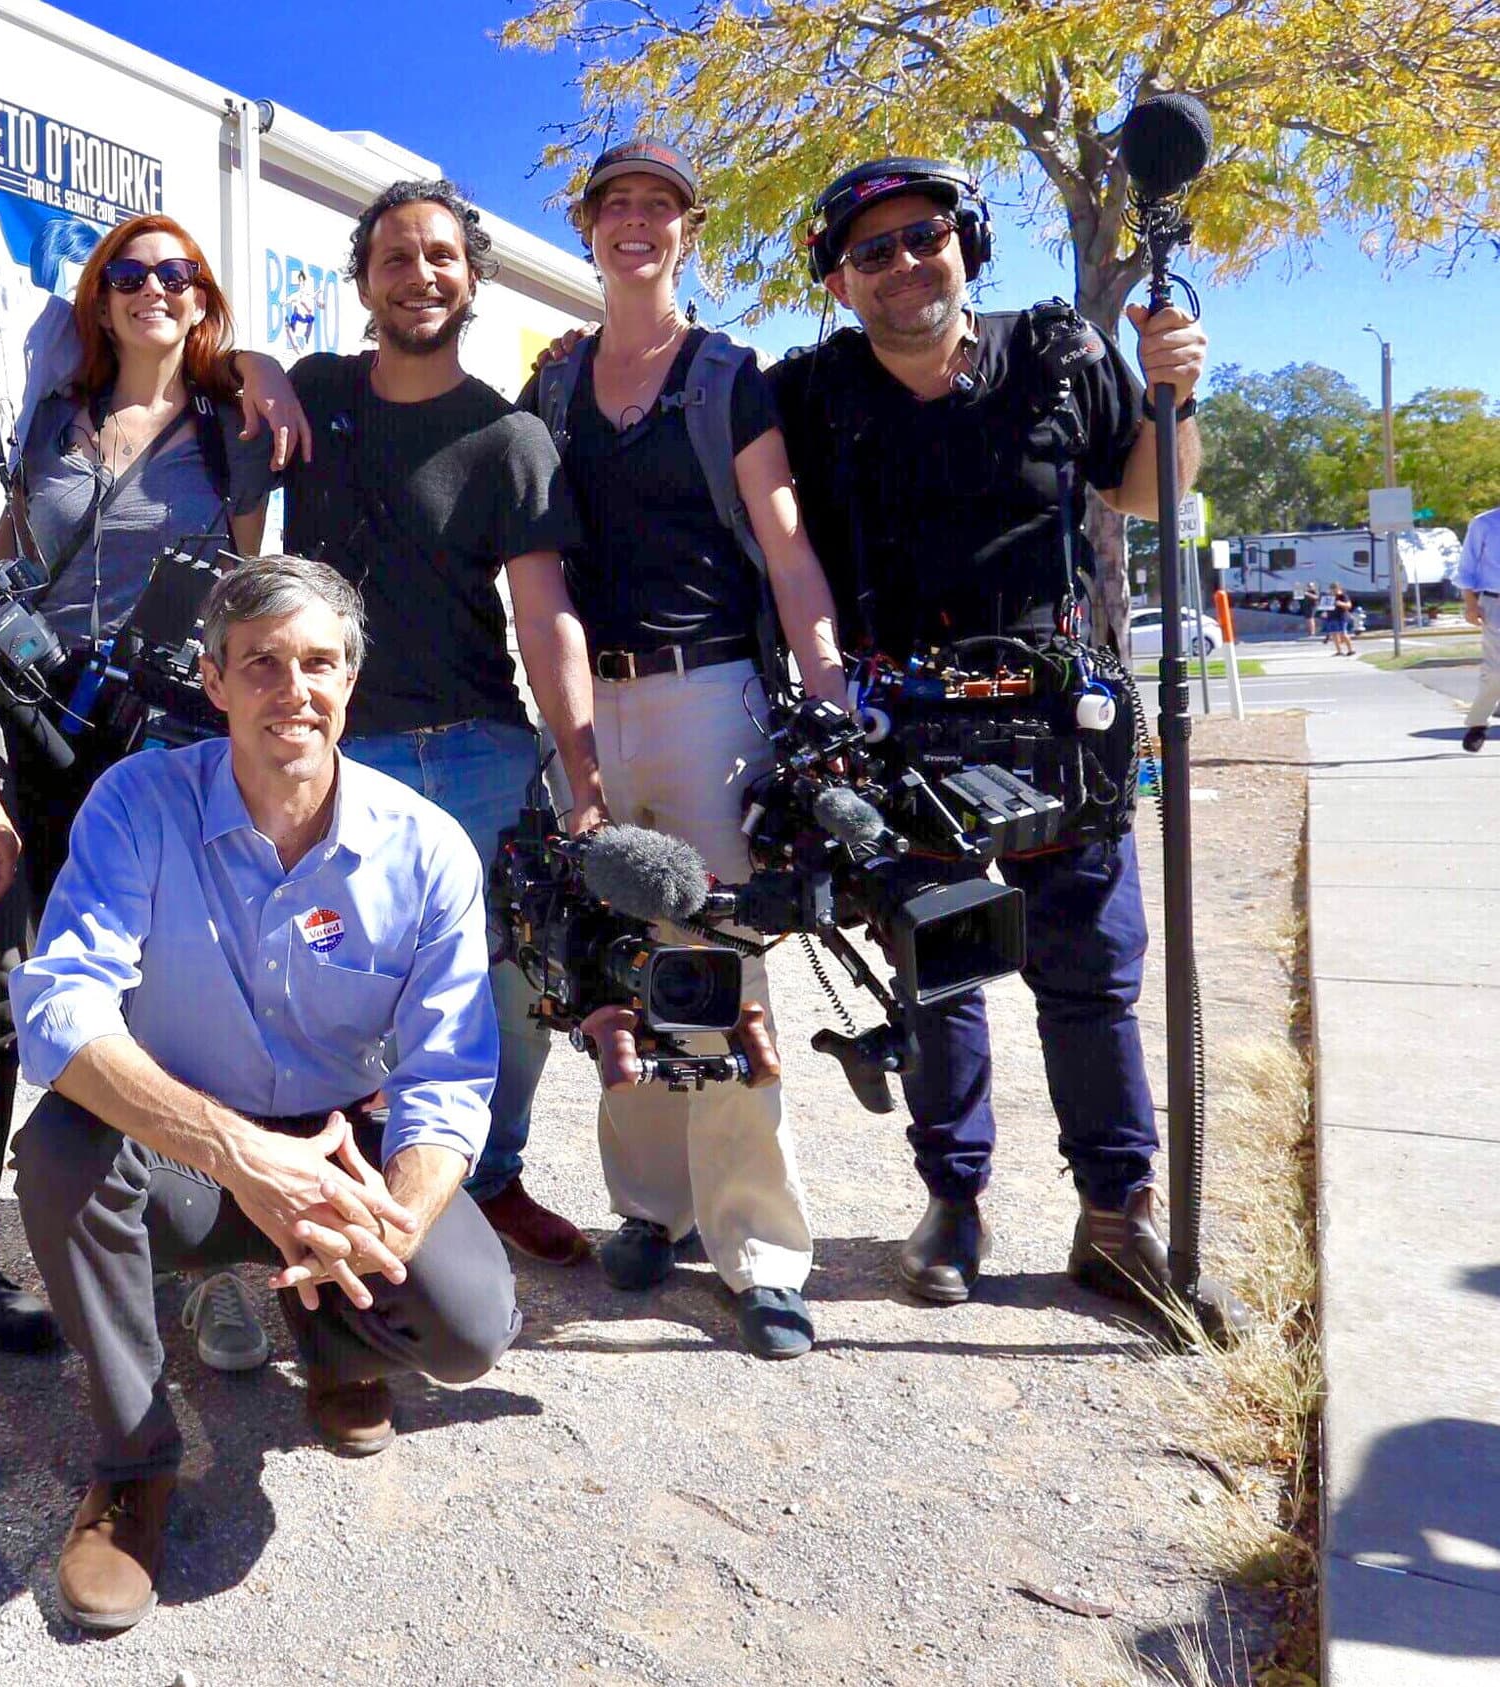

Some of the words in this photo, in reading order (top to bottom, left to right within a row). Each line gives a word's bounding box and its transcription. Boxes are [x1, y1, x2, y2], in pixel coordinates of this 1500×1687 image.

[27, 176, 44, 203] FOR
[45, 182, 63, 208] U.S.
[64, 189, 97, 219] SENATE
[45, 120, 162, 215] O'ROURKE
[266, 248, 340, 352] BETO
[309, 923, 340, 938] Voted
